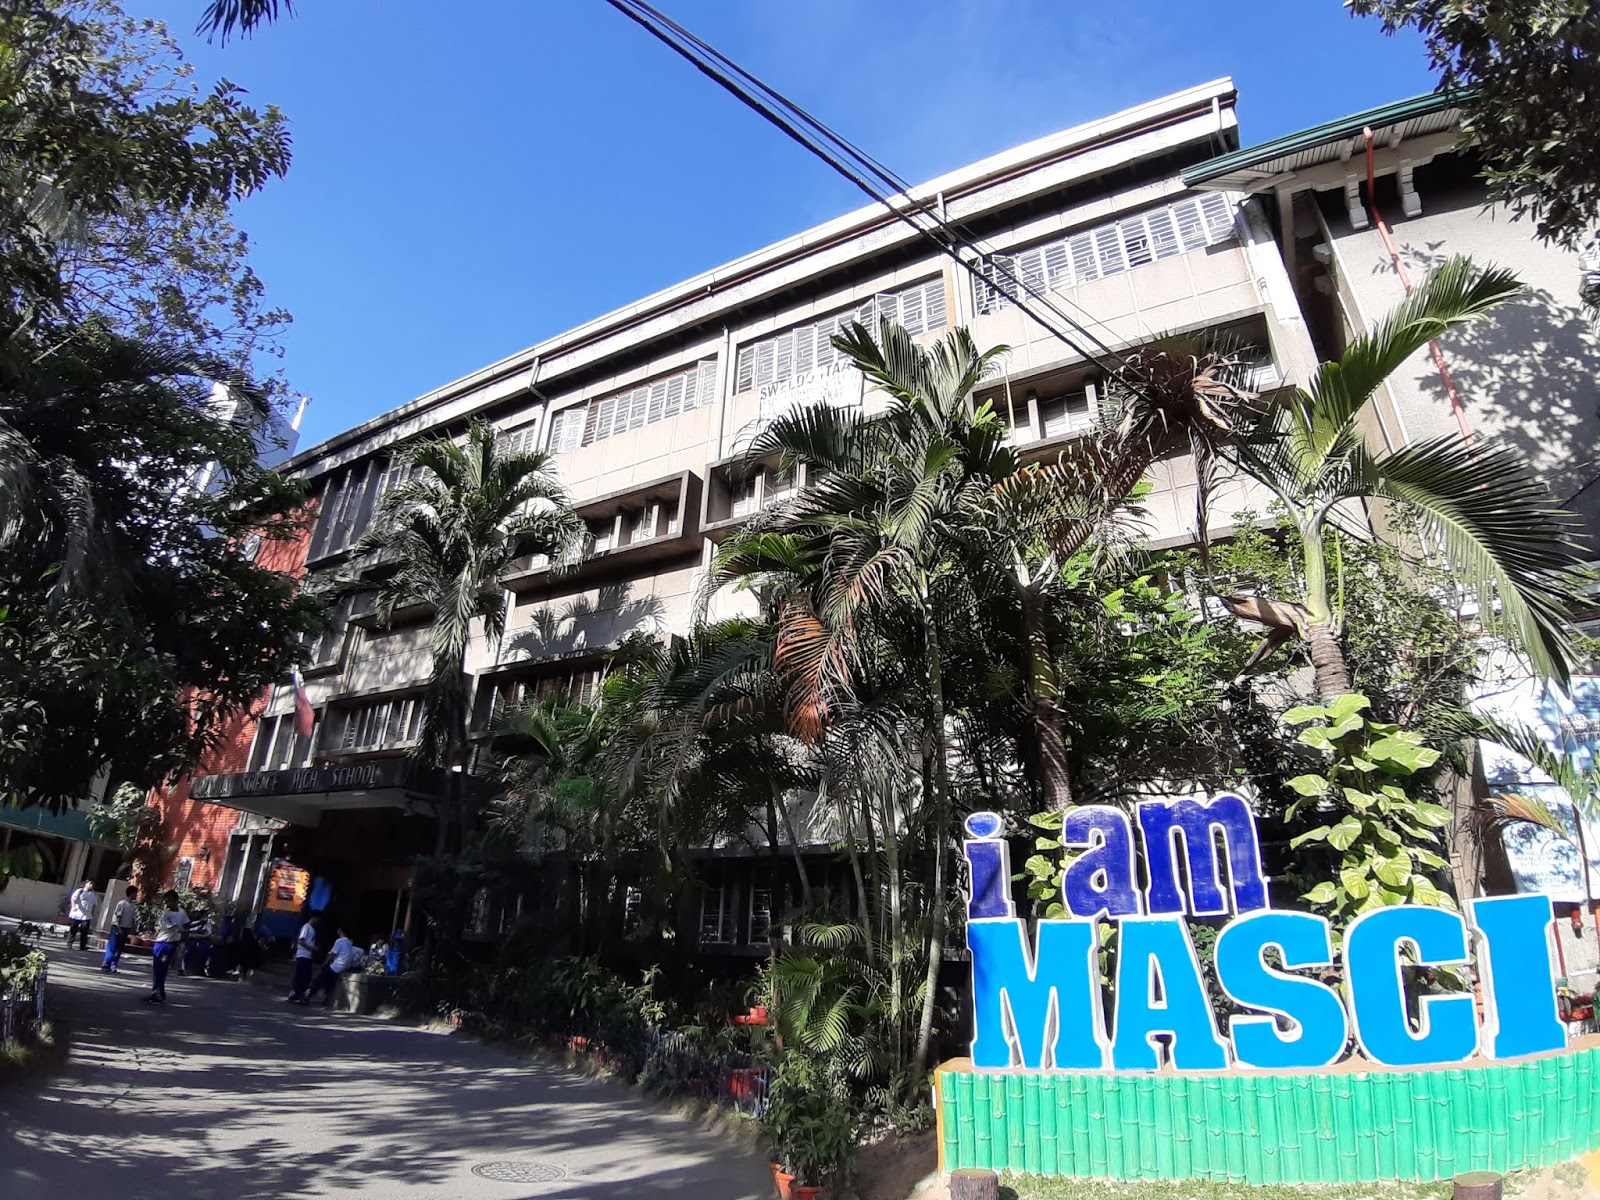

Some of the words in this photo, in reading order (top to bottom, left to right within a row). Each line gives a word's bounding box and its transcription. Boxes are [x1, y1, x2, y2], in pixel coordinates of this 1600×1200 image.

[292, 769, 319, 789] HIGH
[330, 764, 376, 785] SCHOOL
[964, 811, 1010, 919] i
[1062, 792, 1271, 919] am
[966, 895, 1569, 1071] MASCI
